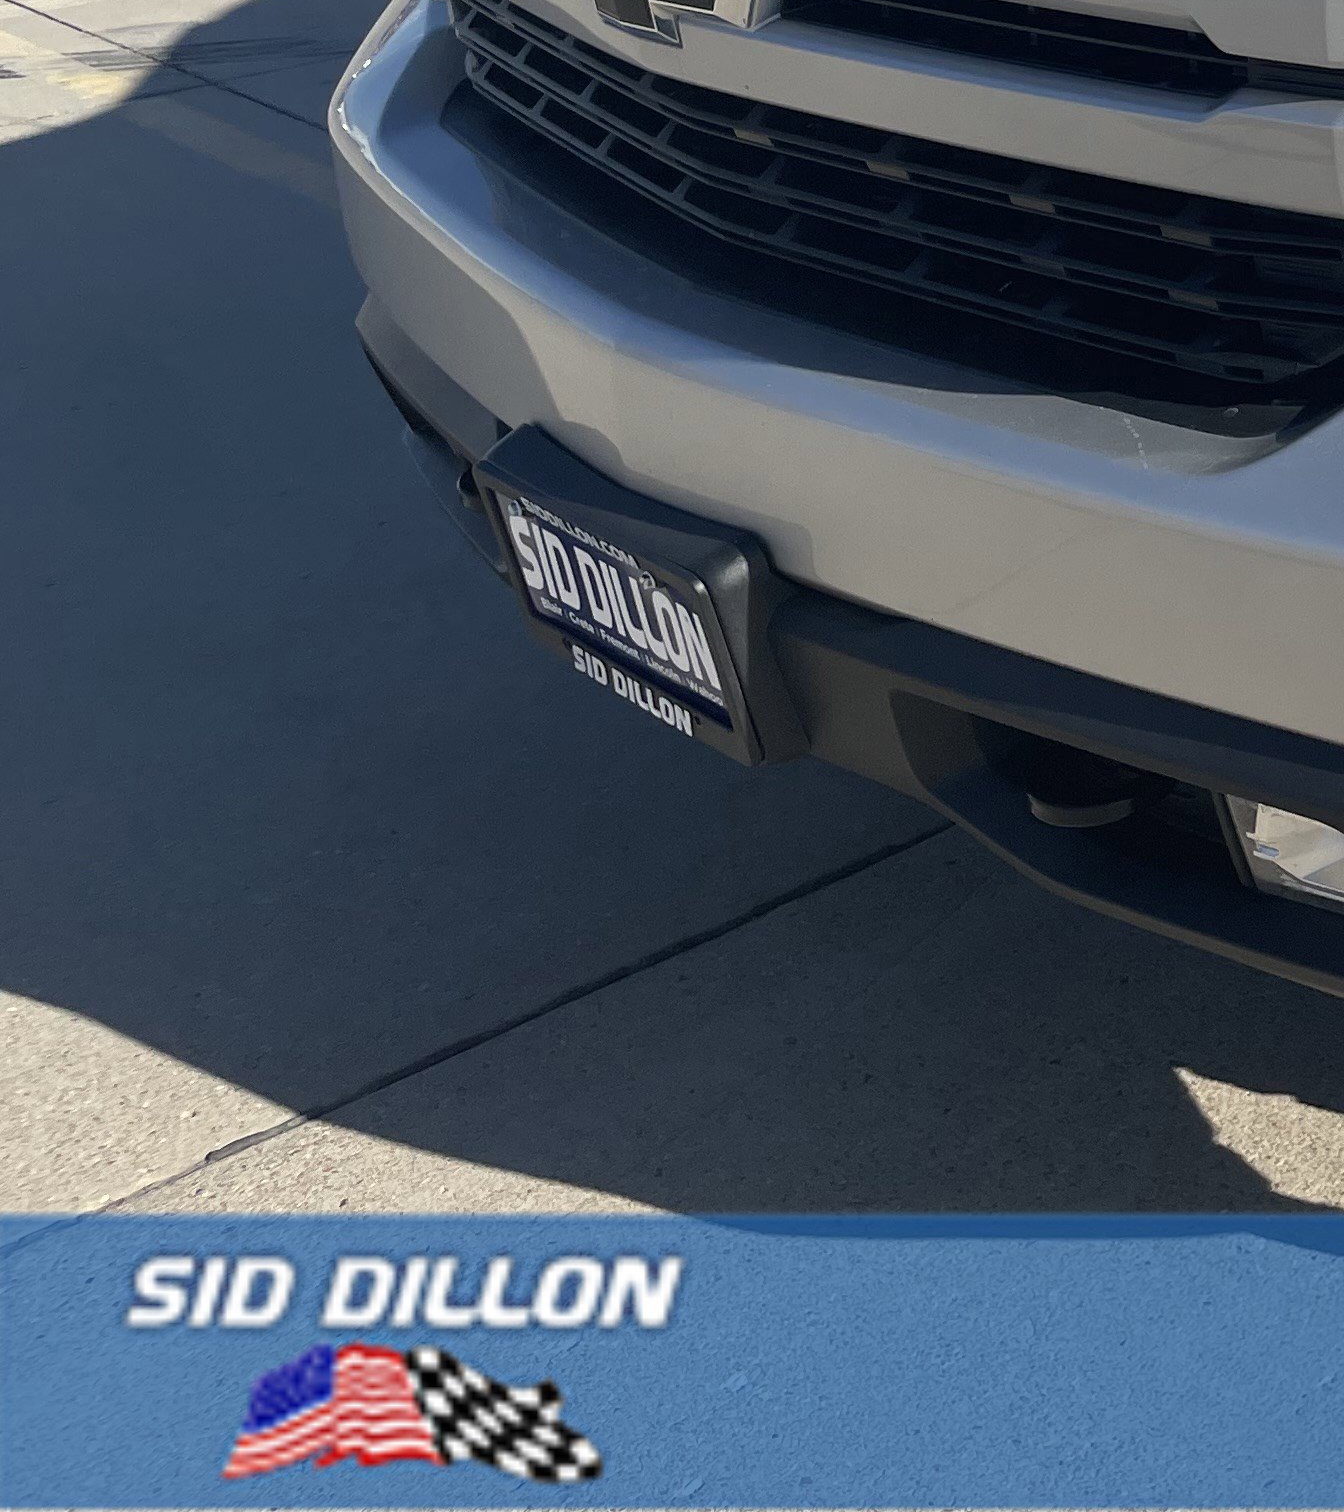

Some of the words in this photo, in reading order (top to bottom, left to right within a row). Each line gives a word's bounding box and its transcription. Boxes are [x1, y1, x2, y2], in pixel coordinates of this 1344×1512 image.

[509, 515, 580, 610] SID
[573, 545, 722, 691] DILLON
[572, 643, 609, 686] SID
[611, 667, 694, 738] DILLON
